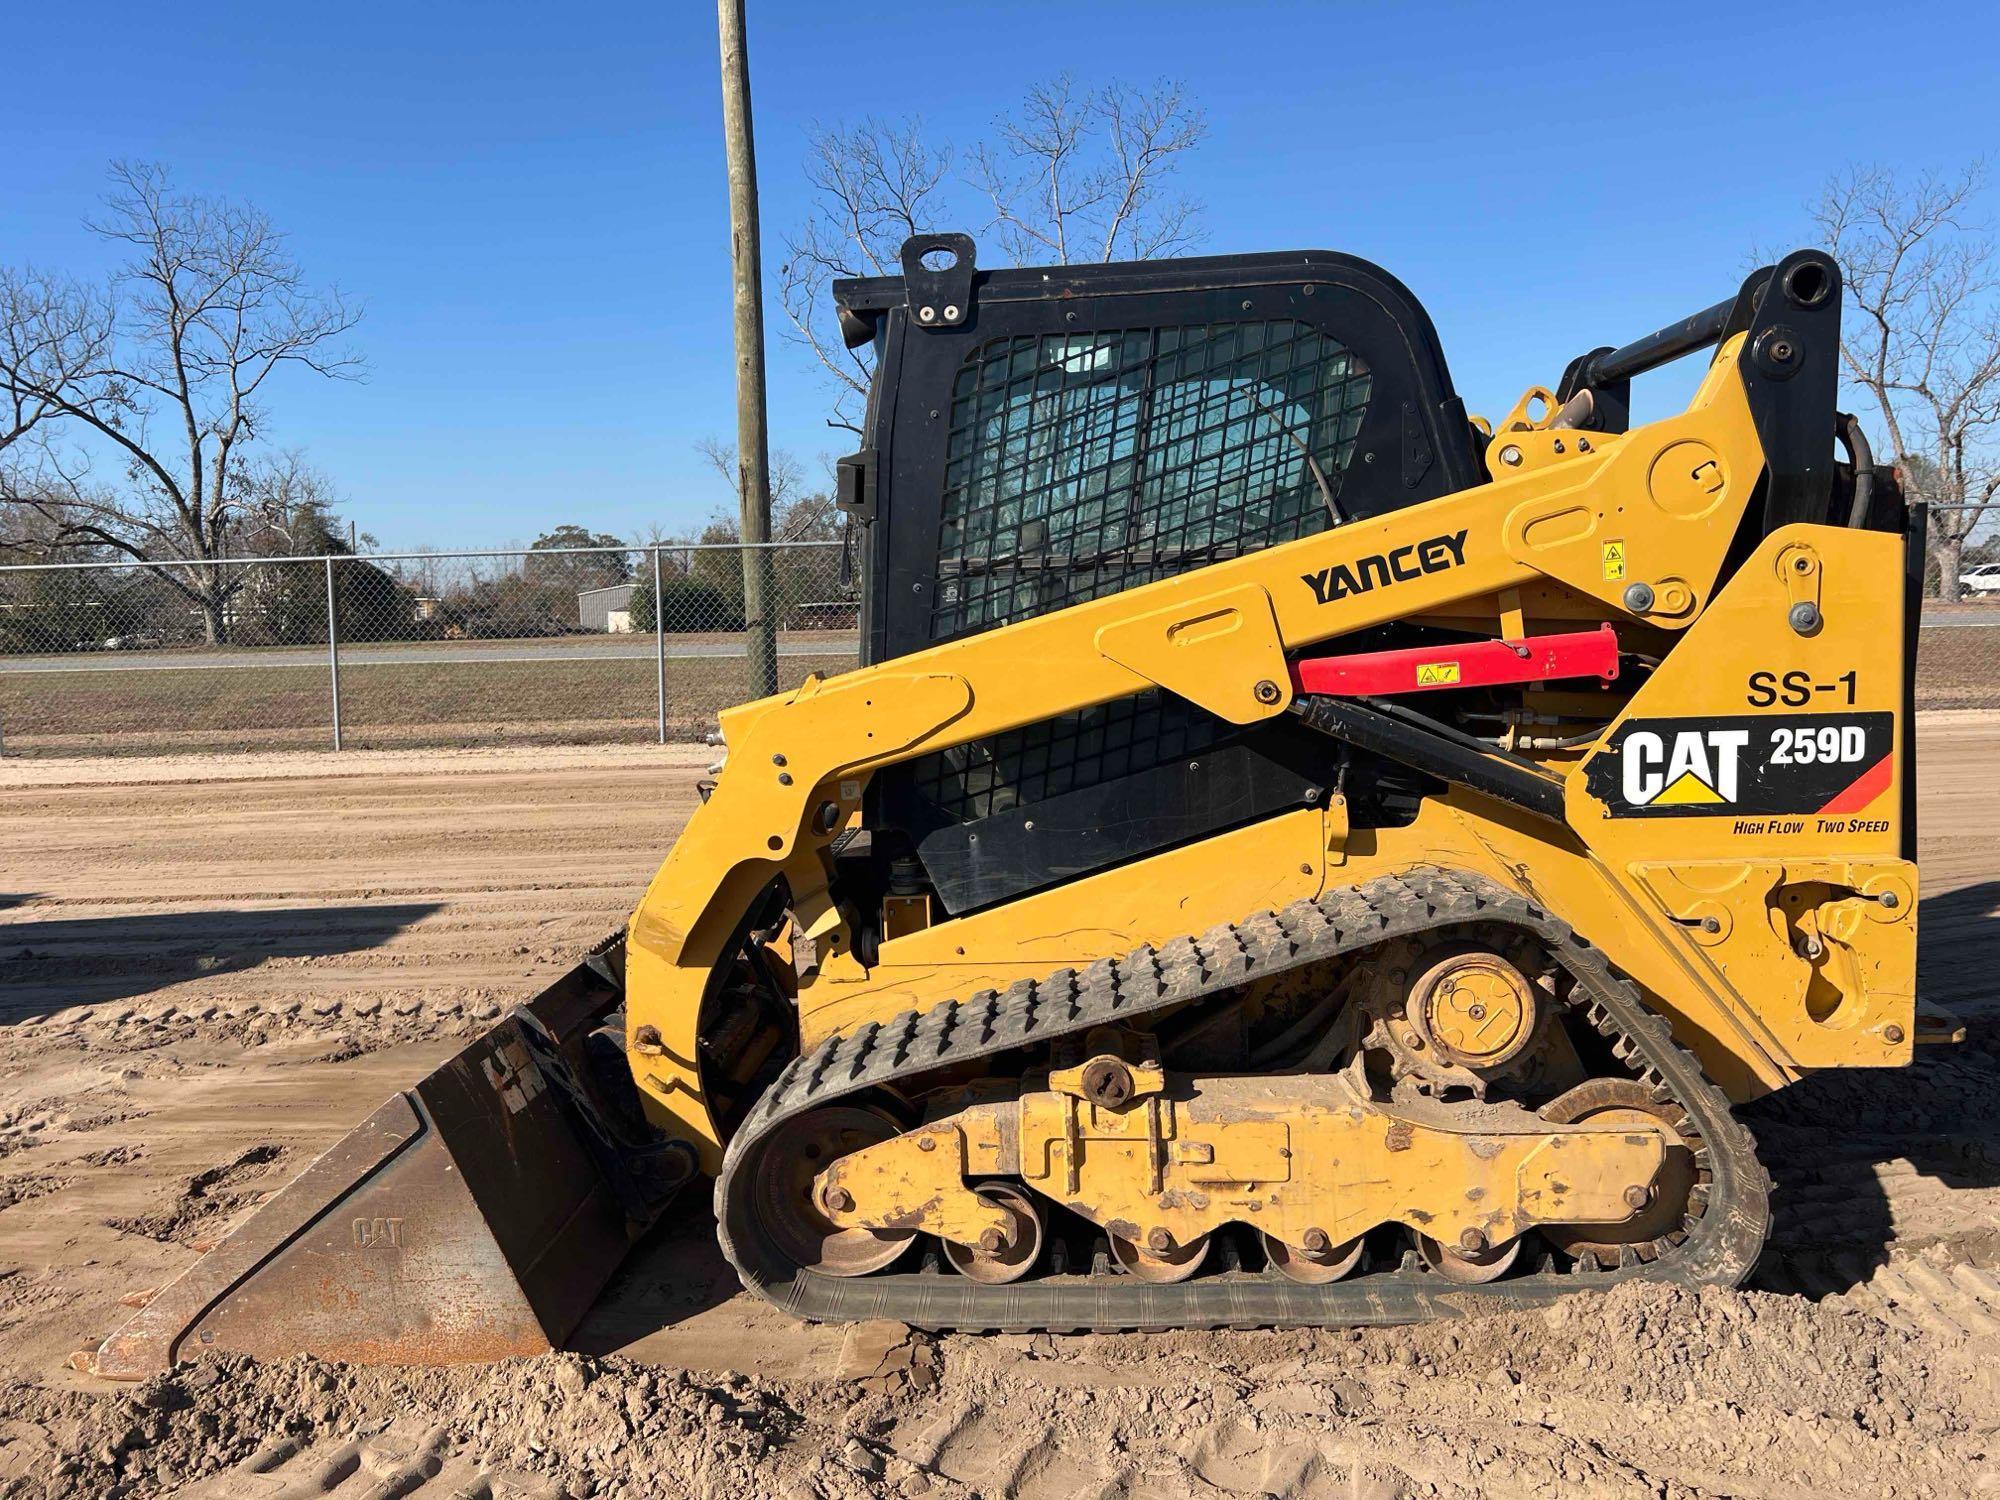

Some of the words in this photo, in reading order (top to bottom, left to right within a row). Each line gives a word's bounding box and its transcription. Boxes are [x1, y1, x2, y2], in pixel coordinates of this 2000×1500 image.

[1300, 529, 1469, 605] YANCEY
[1747, 670, 1858, 708] SS-1
[1622, 730, 1749, 806] CAT
[1769, 726, 1867, 765] 259D
[1733, 821, 1765, 835] HIGH
[1767, 820, 1805, 834] FLOW
[1817, 820, 1845, 833] TWO
[1848, 819, 1890, 833] SPEED
[353, 1217, 404, 1249] CAT
